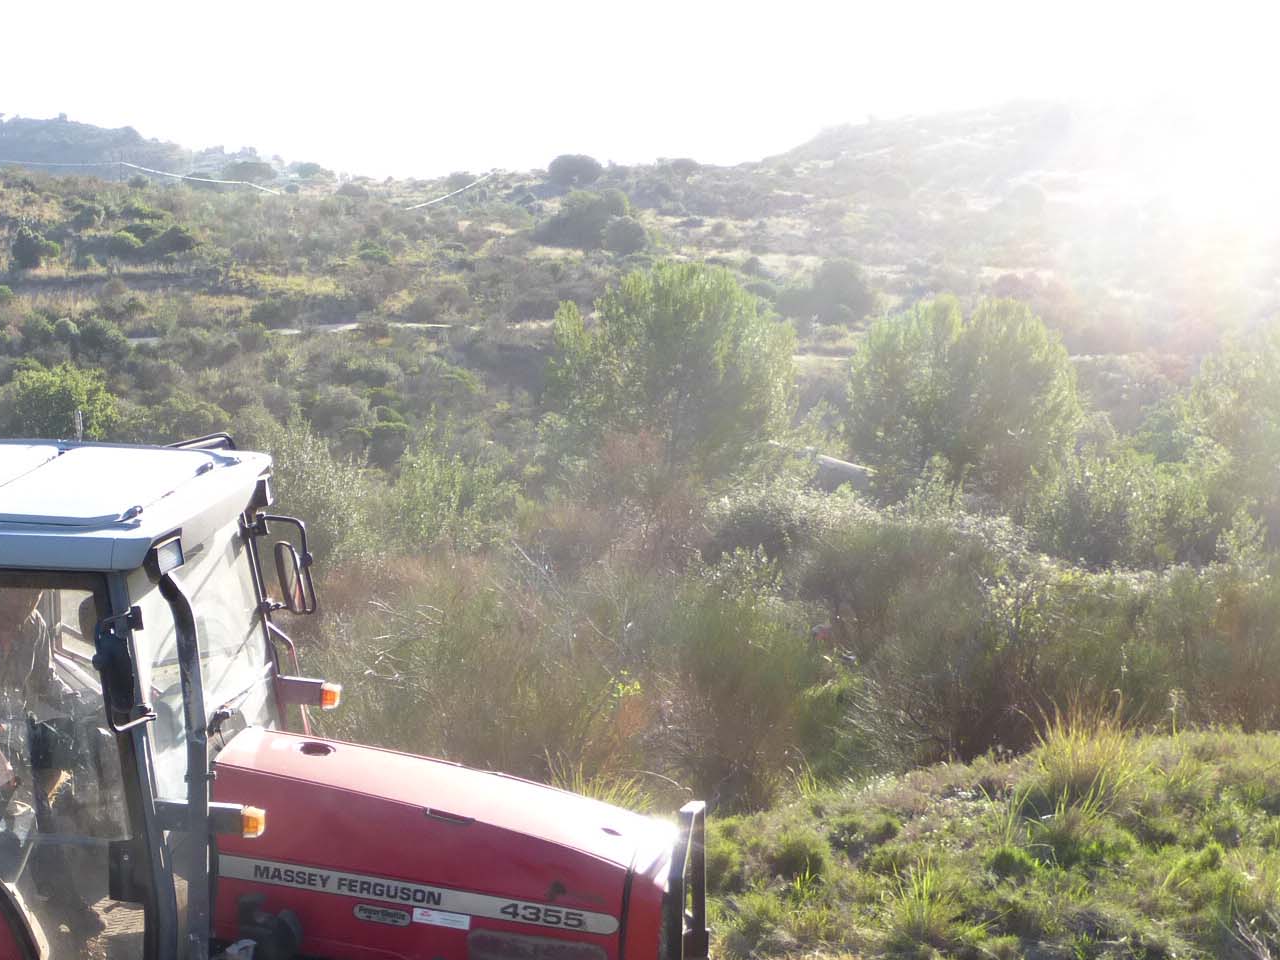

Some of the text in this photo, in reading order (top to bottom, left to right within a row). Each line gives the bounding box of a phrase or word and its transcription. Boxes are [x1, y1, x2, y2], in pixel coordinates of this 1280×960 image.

[254, 864, 441, 905] MASSEY FERGUSON
[500, 903, 585, 928] 4355
